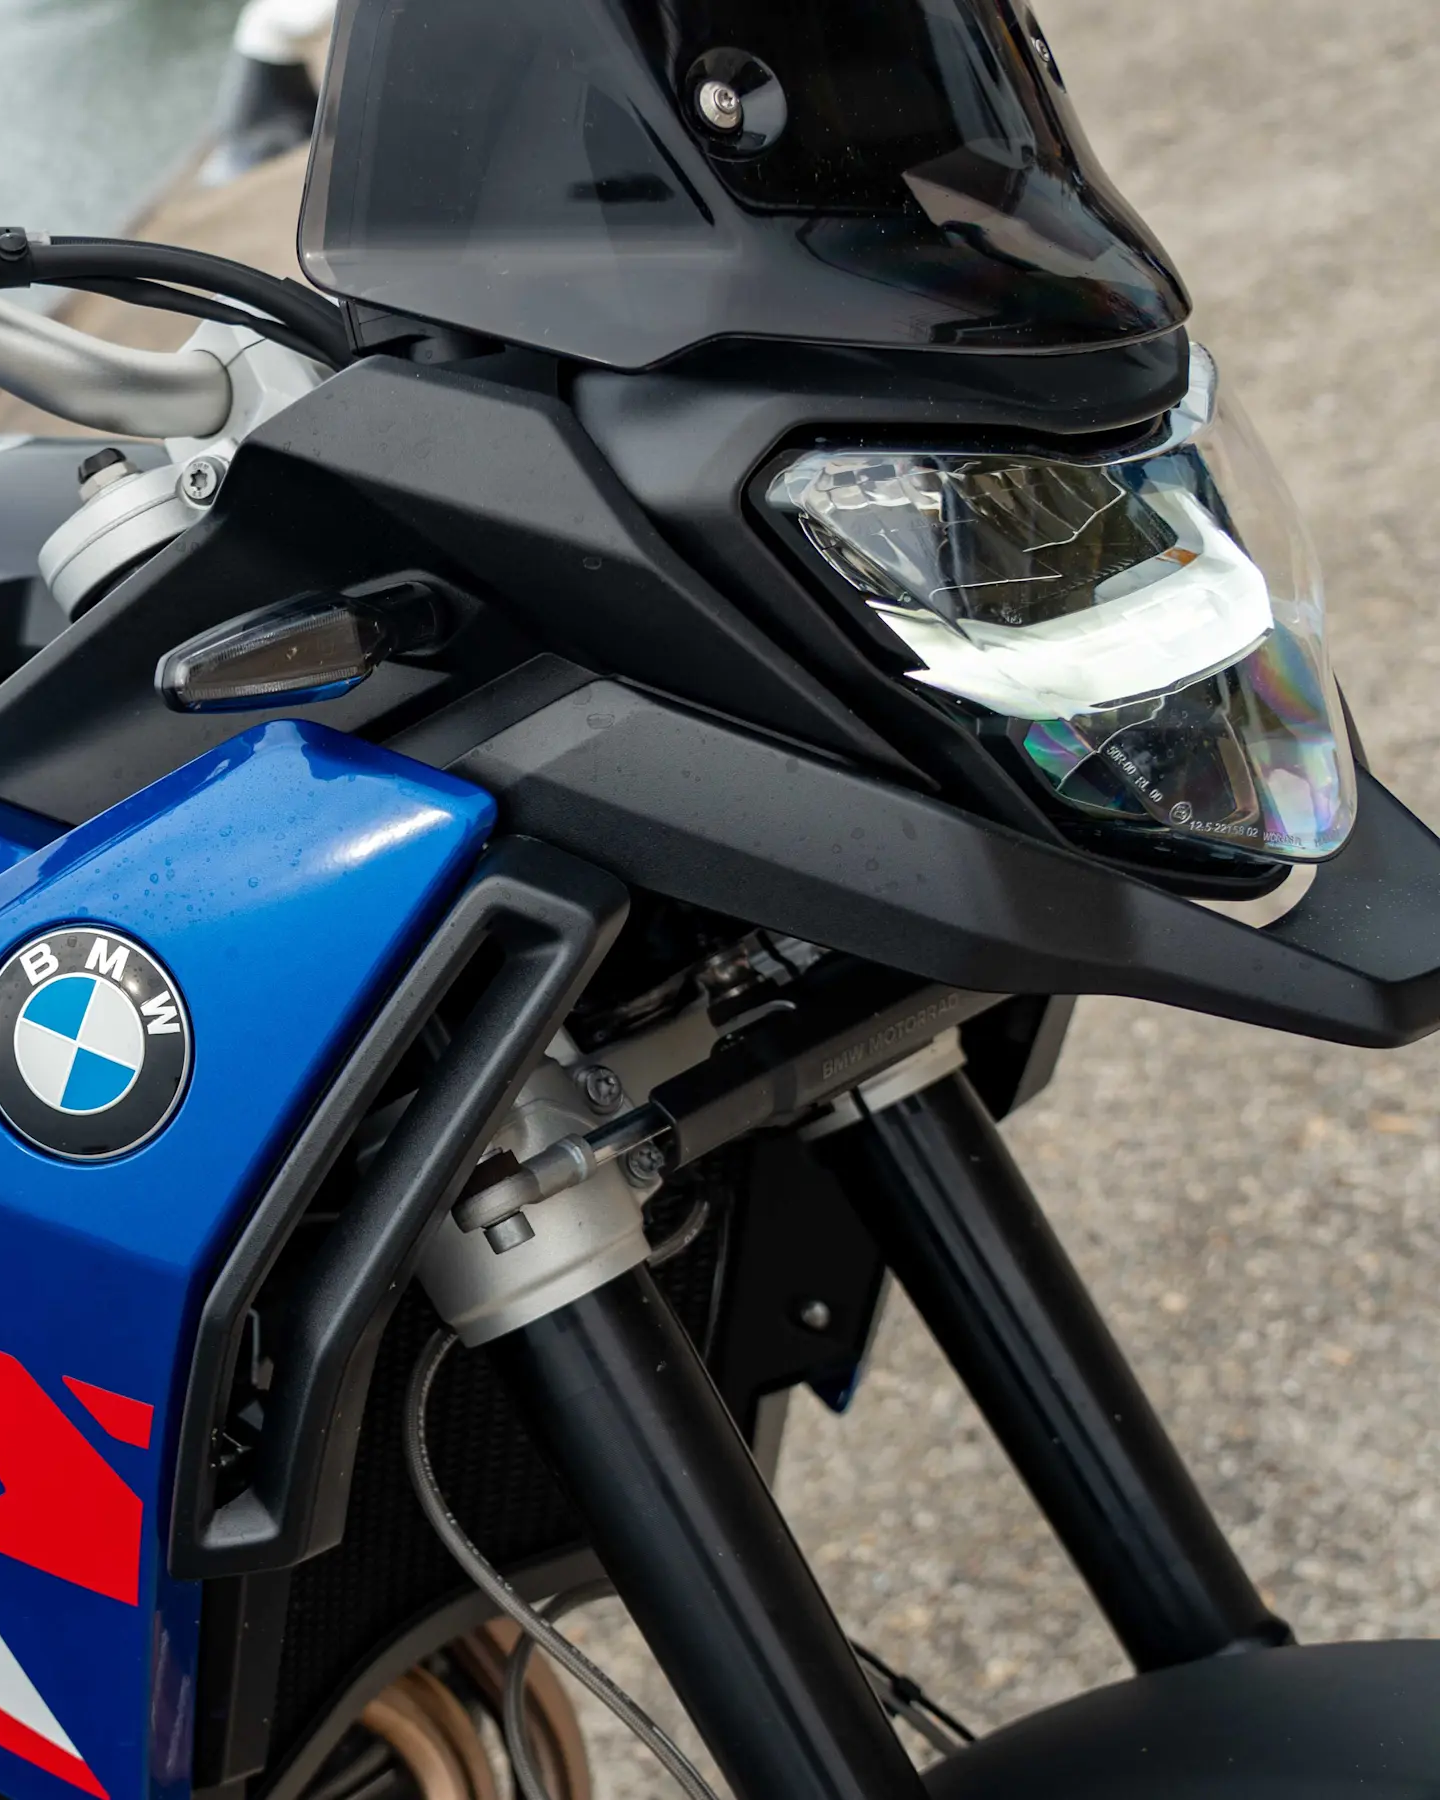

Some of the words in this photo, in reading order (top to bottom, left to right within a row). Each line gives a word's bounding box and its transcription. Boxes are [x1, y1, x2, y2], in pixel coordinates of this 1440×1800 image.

[19, 937, 181, 1035] BMW
[822, 1044, 866, 1080] BMW
[867, 993, 959, 1056] MOTORRAD
